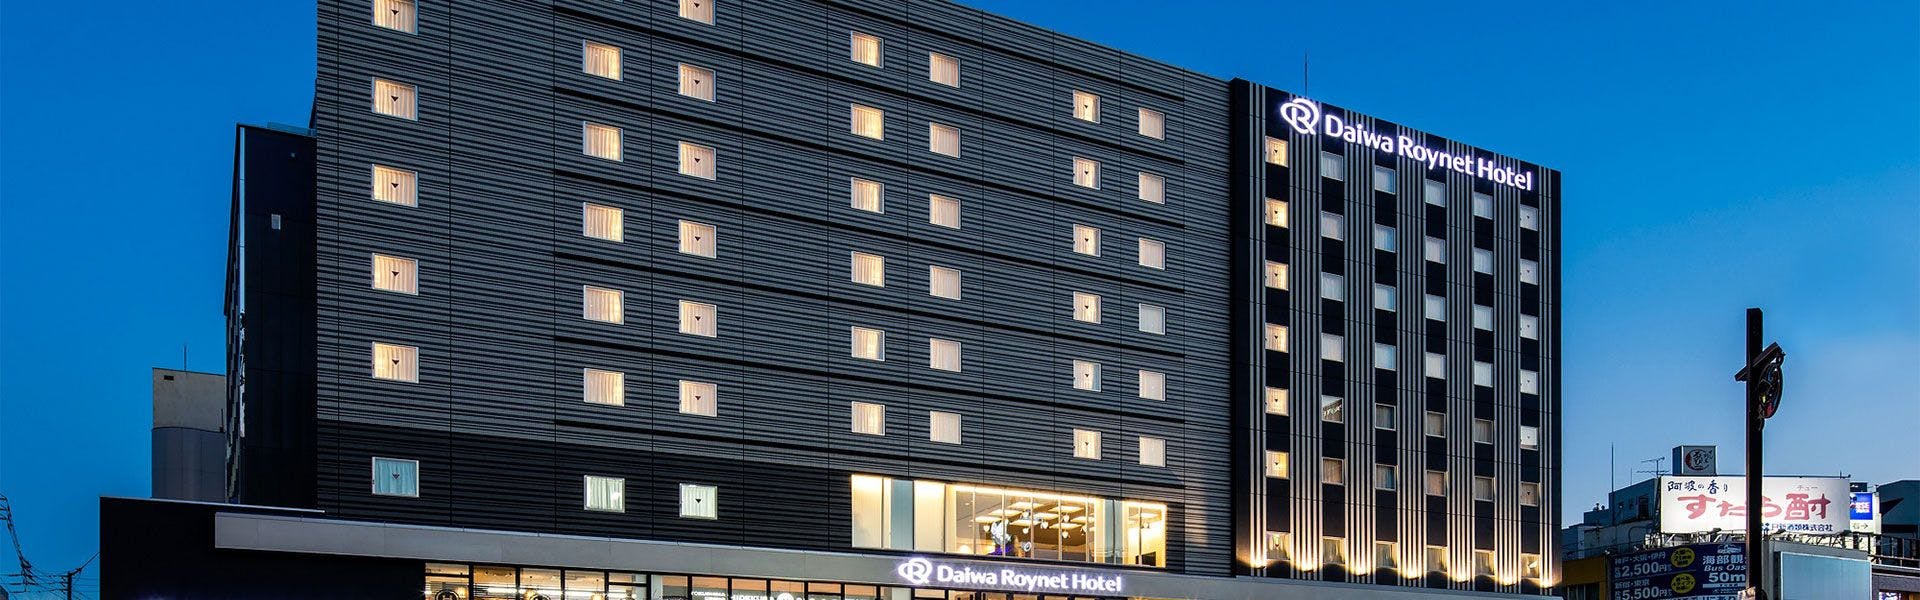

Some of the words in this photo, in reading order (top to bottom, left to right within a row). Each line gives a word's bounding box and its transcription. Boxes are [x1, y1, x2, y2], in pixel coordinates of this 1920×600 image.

[1325, 114, 1393, 153] Daiwa
[1398, 135, 1474, 175] Roynet
[1477, 157, 1532, 191] Hotel
[1667, 479, 1728, 494] 阿波の香り
[1702, 554, 1747, 565] 海部観
[1704, 564, 1724, 572] Bus
[937, 565, 998, 585] Daiwa
[1001, 569, 1069, 591] Roynet
[1072, 574, 1122, 591] Hotel
[1708, 573, 1746, 583] 50m
